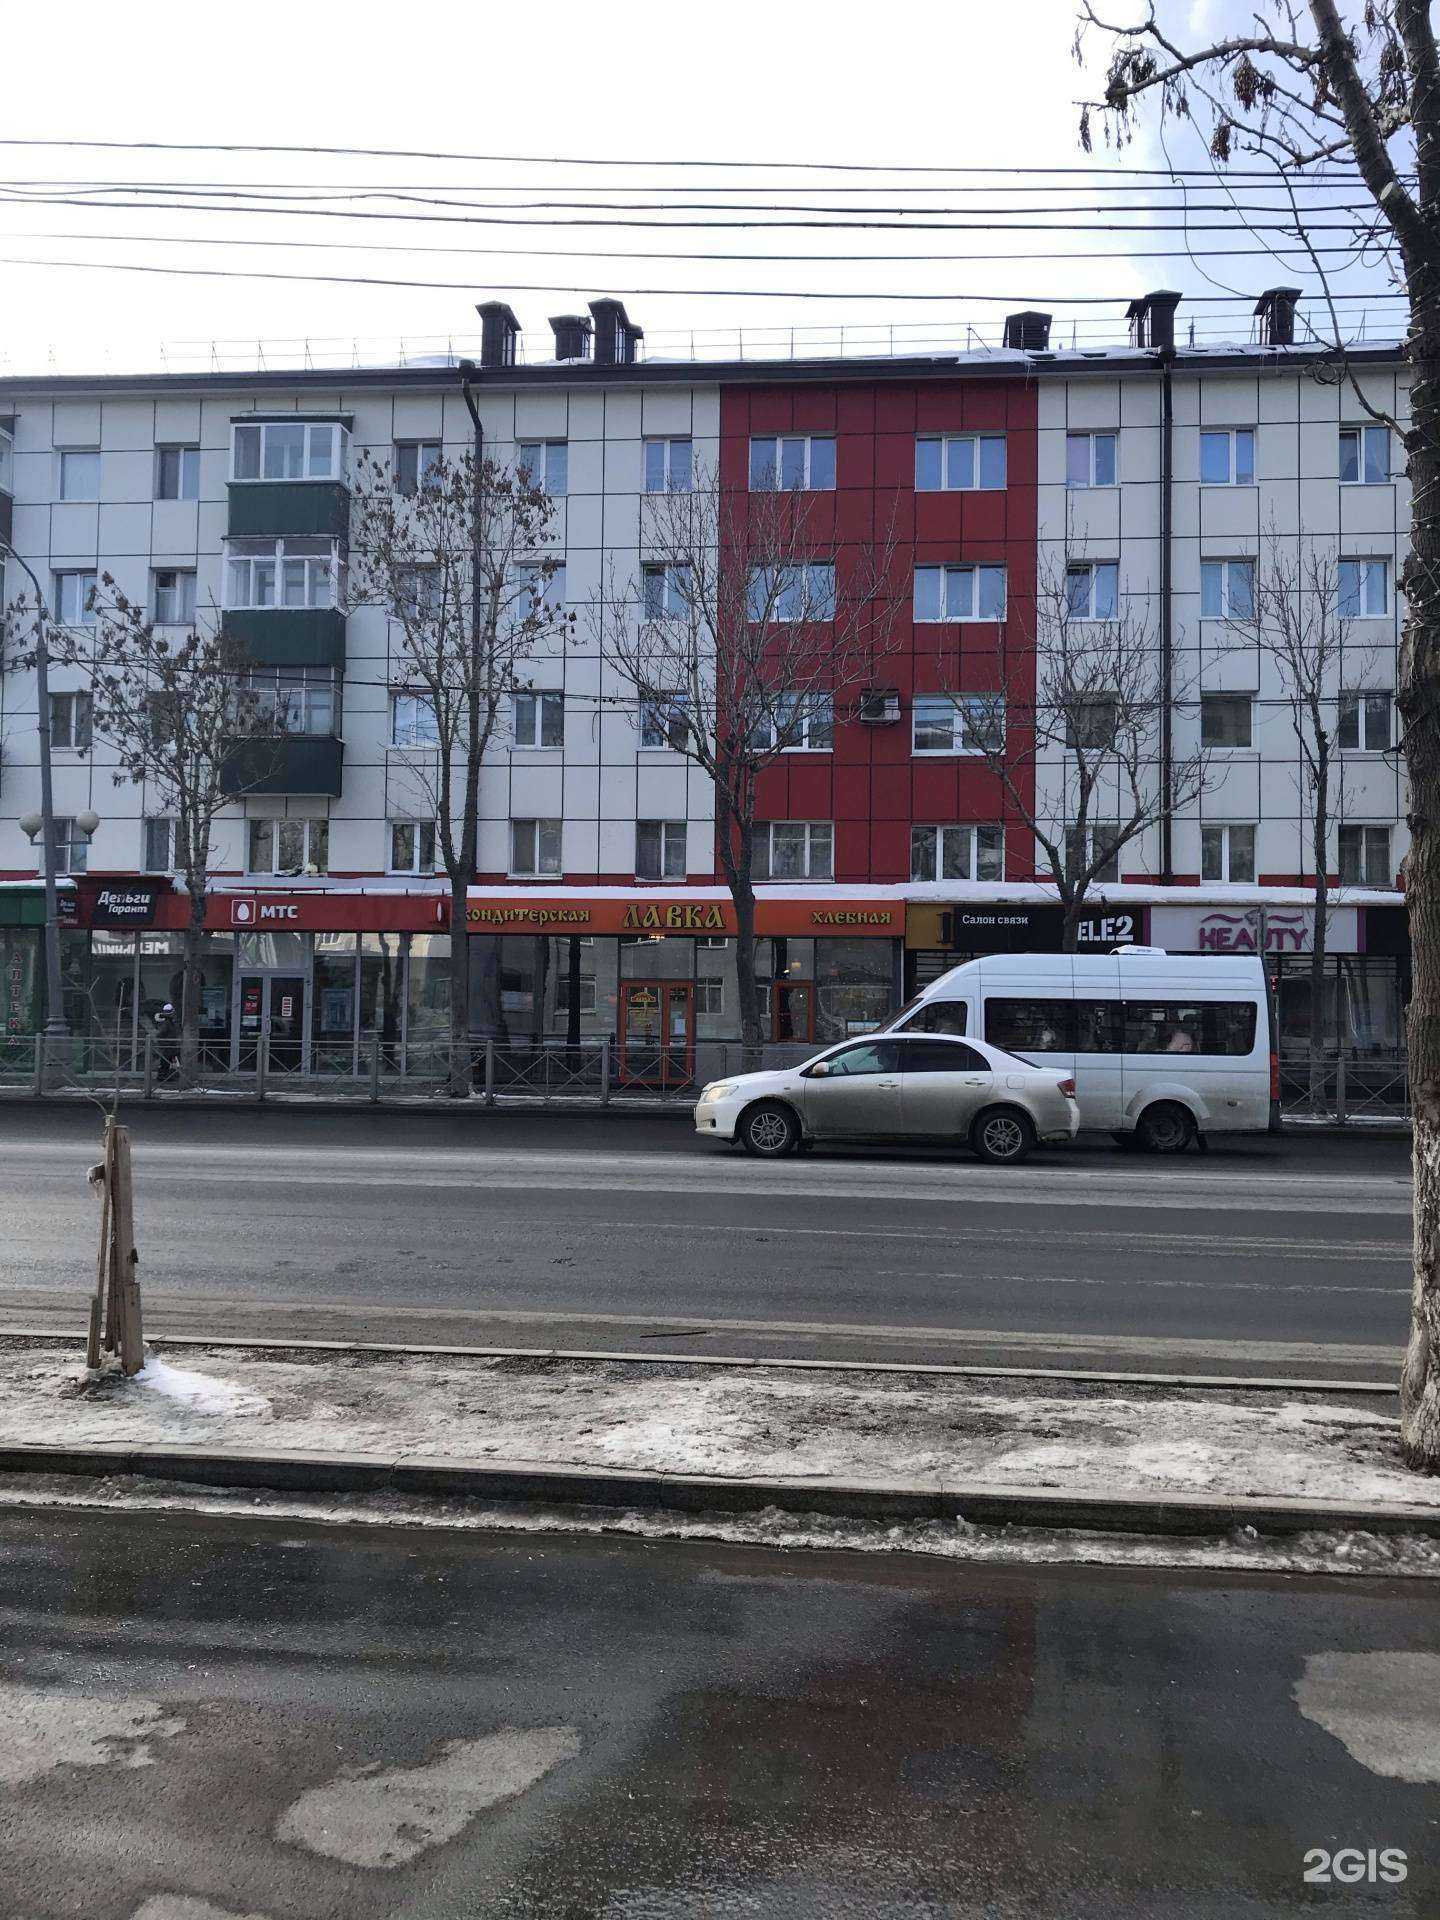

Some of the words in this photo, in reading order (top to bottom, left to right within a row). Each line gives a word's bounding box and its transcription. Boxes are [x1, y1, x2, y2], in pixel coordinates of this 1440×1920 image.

[97, 890, 151, 905] Деньги
[108, 904, 148, 915] Гарант
[260, 905, 298, 919] МТС
[622, 904, 726, 928] ЛАВКА
[962, 914, 996, 925] Салон
[997, 915, 1029, 925] связи
[1077, 915, 1134, 942] ELE2
